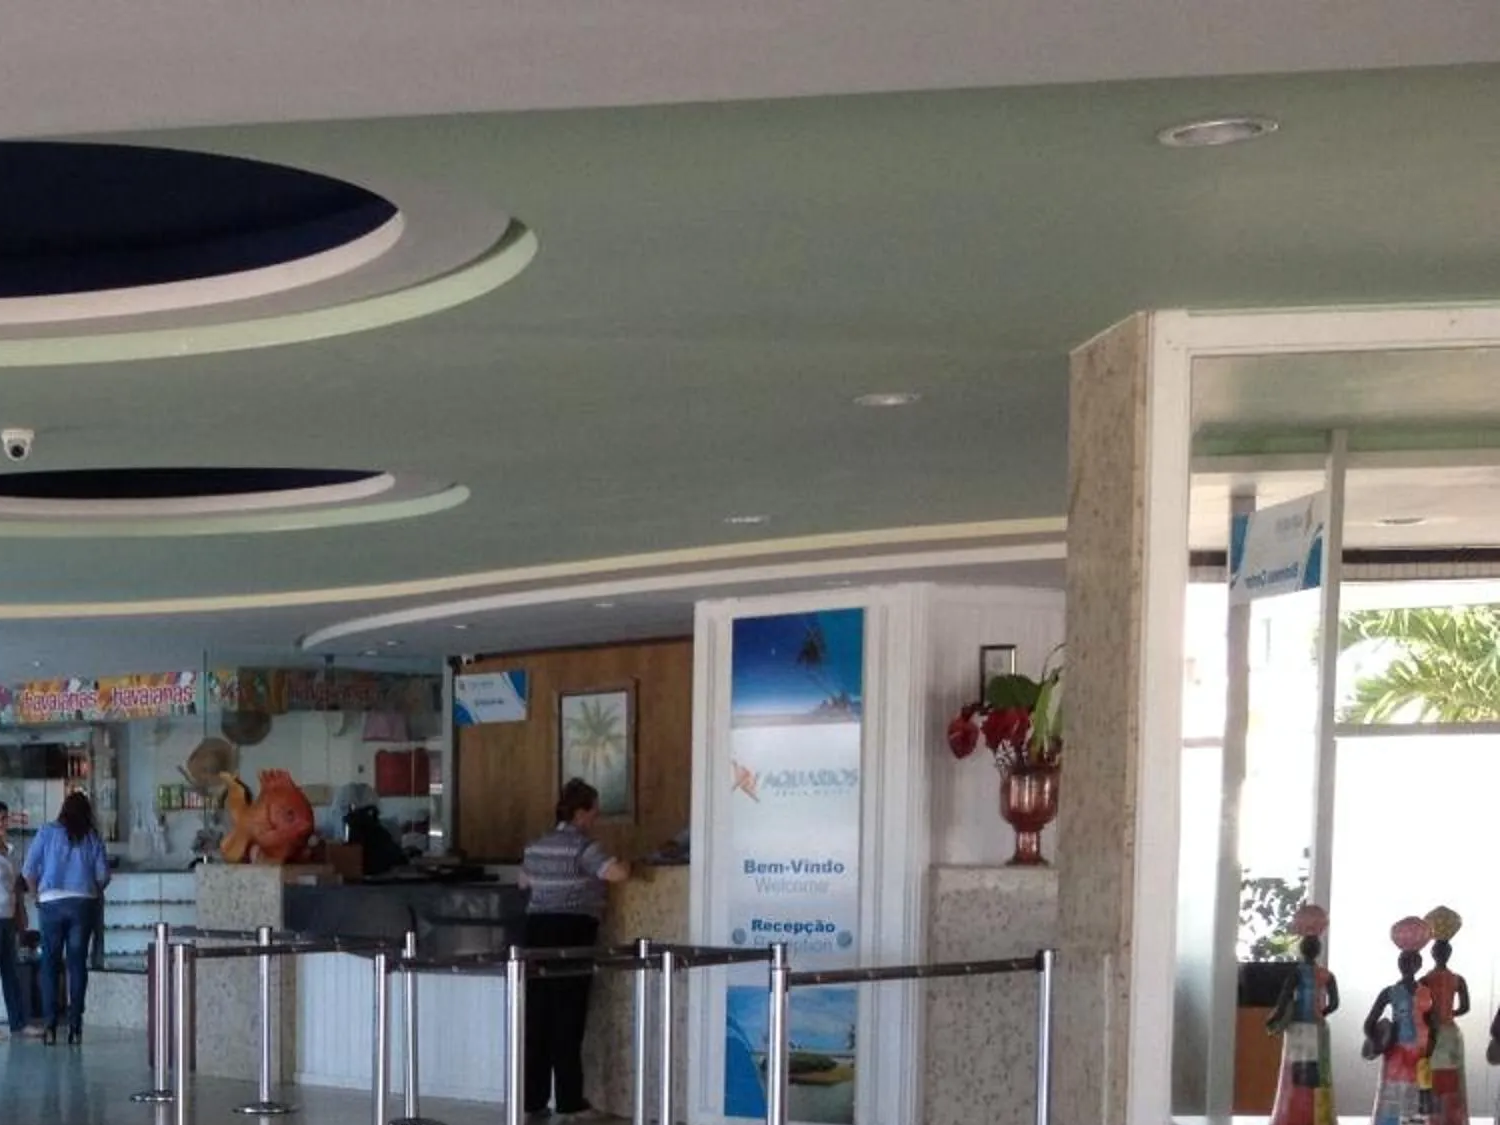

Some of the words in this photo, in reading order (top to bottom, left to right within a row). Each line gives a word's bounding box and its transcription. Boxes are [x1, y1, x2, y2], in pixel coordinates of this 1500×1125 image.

[111, 685, 193, 706] havaianas
[743, 858, 845, 875] Bem-Vindo
[754, 876, 830, 894] Welcome
[751, 917, 836, 936] Recepção
